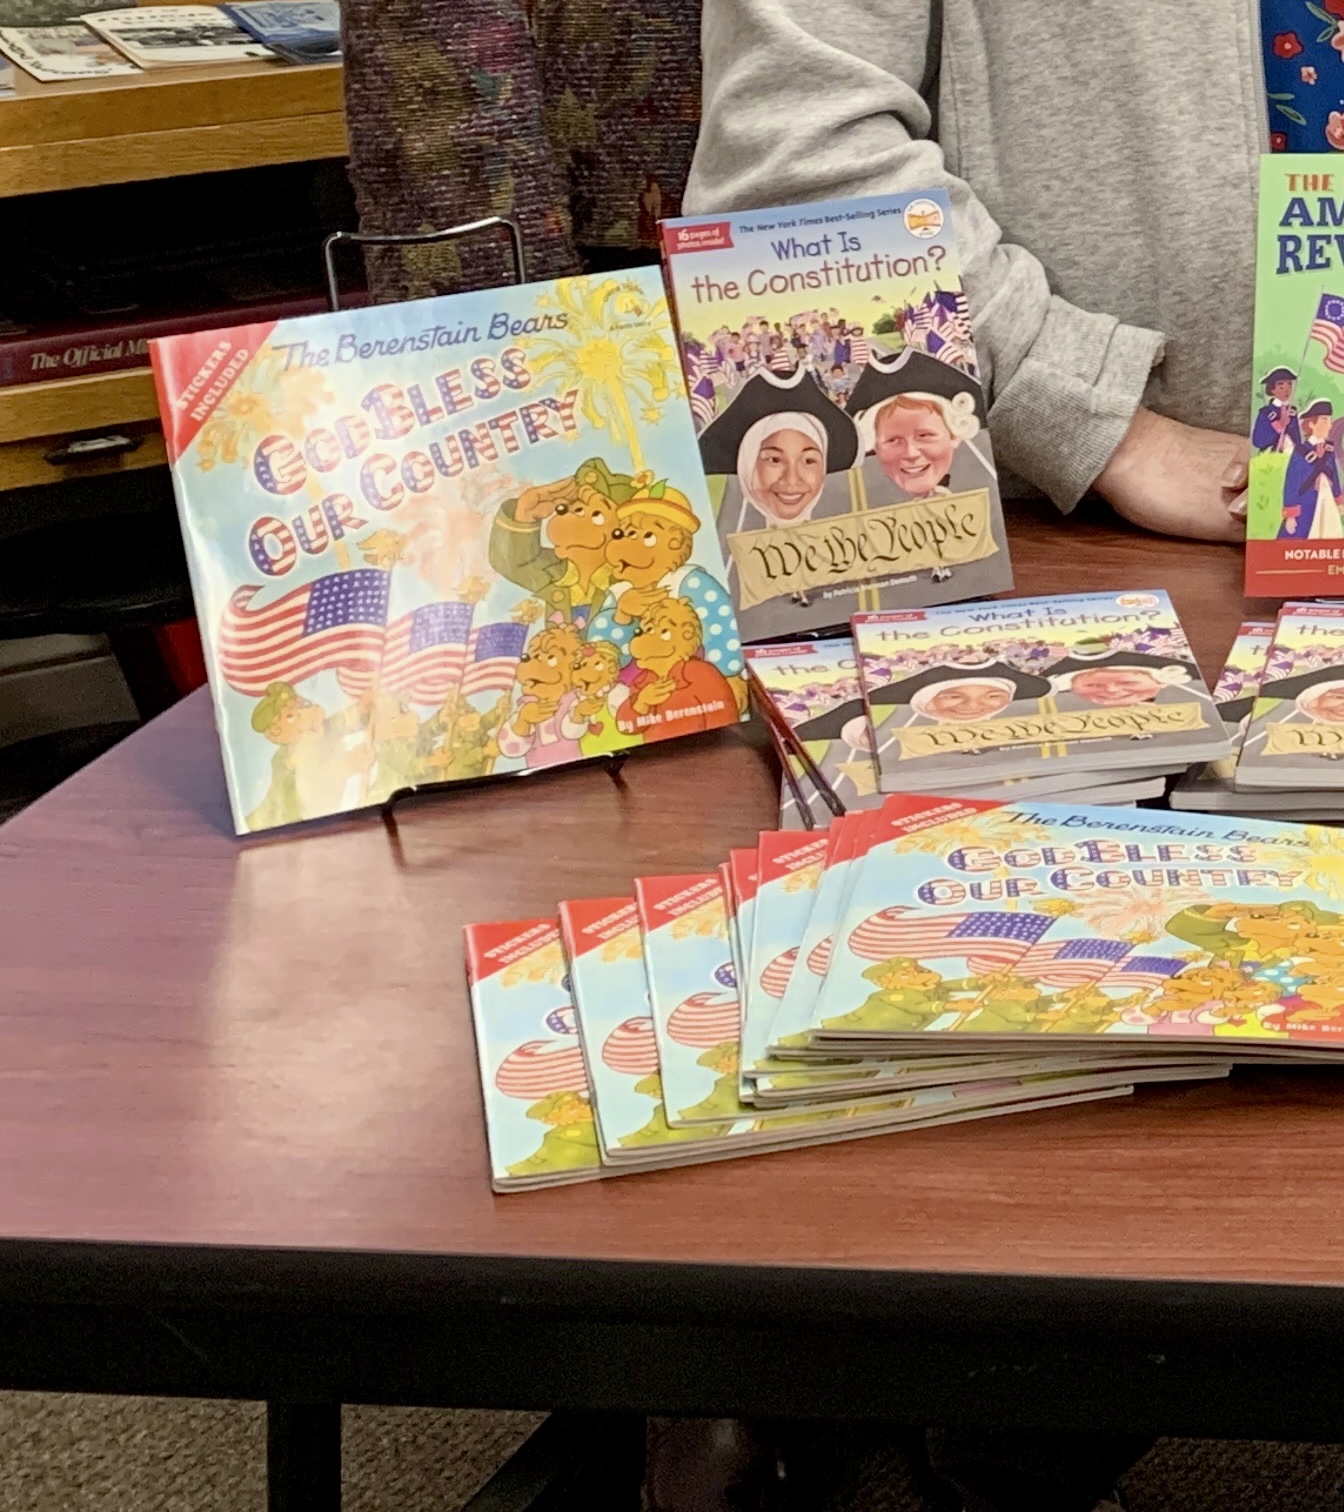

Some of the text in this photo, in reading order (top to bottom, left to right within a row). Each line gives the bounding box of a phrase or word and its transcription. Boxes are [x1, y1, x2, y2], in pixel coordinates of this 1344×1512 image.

[1285, 173, 1335, 192] THE
[691, 246, 946, 303] the Constitution?
[771, 232, 861, 260] What Is
[272, 312, 569, 372] The Berenstain Bears
[175, 341, 232, 410] STICKERS
[190, 348, 249, 422] INCLUDED
[361, 348, 532, 440] BLESS
[249, 389, 578, 576] OUR COUNTRY
[750, 542, 818, 579] We
[862, 504, 978, 571] People
[1285, 548, 1340, 560] NOTABLE
[637, 712, 663, 727] Mike
